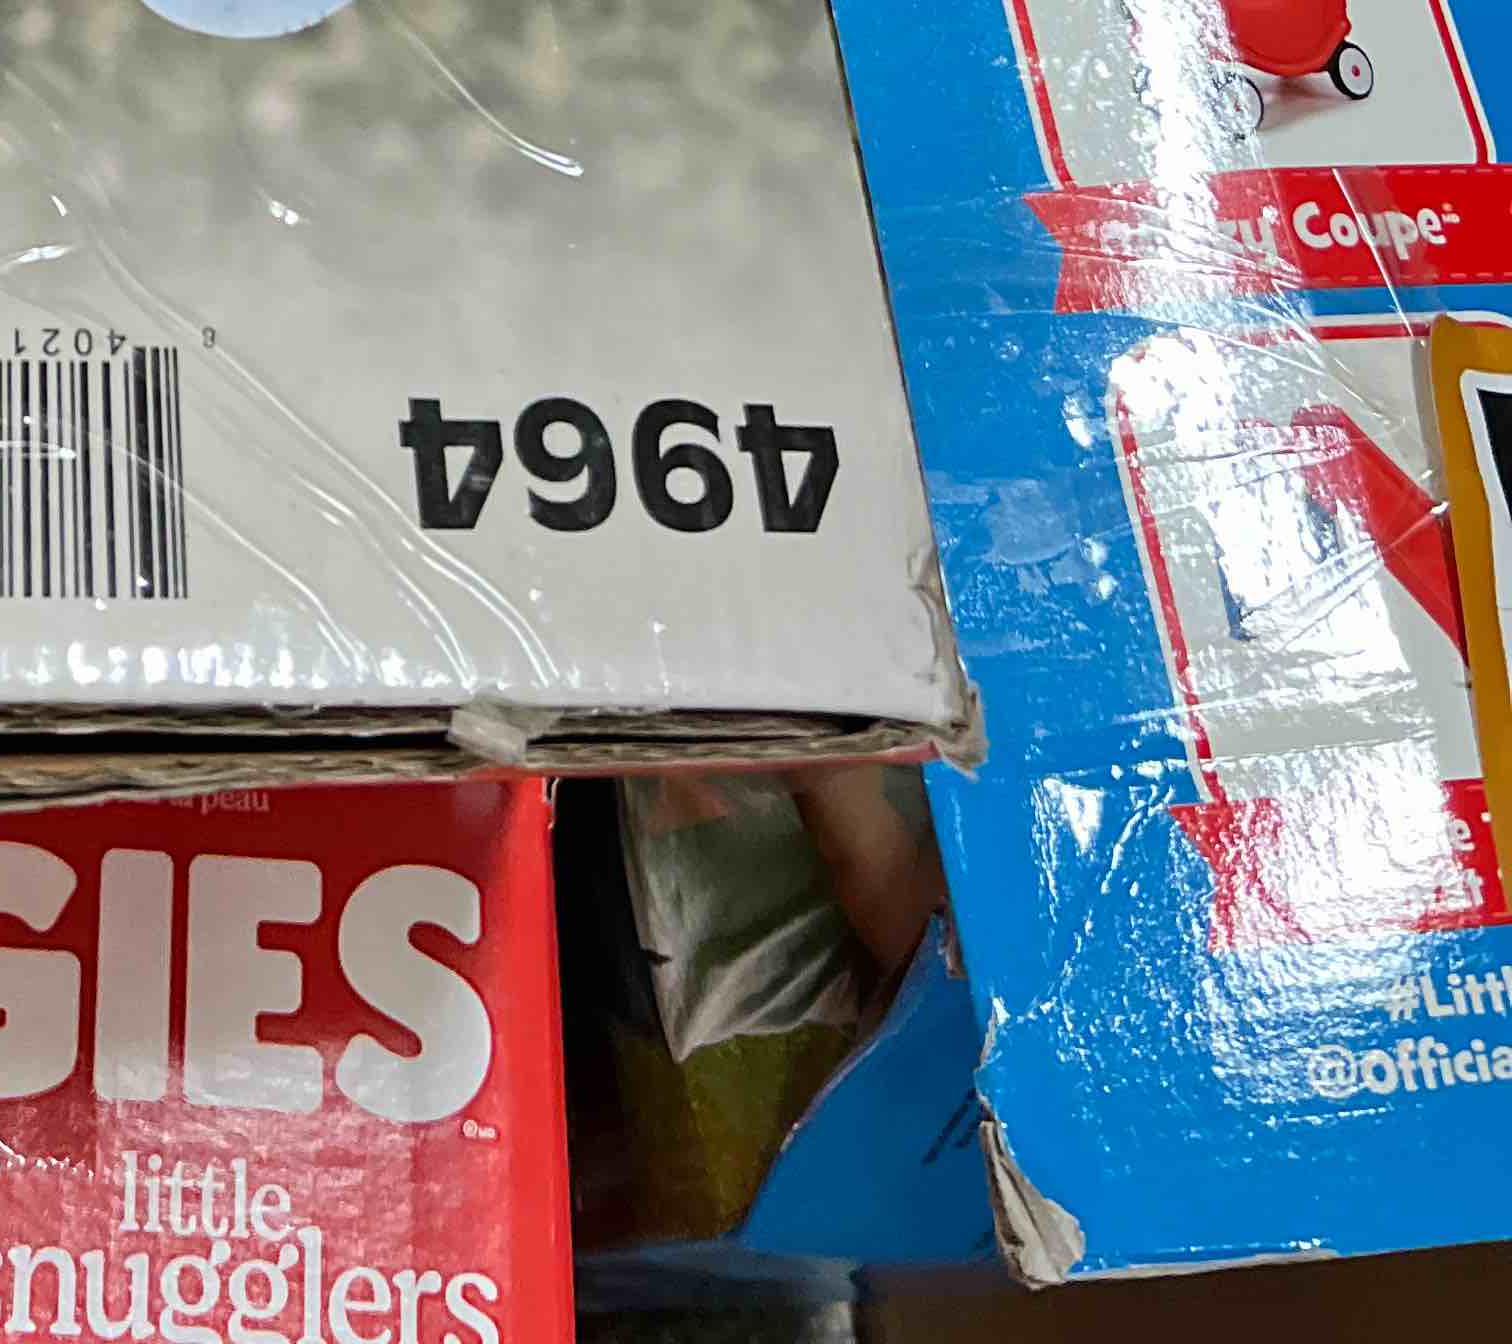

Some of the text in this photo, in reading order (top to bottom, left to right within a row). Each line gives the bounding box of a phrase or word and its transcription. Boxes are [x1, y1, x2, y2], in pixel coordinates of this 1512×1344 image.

[1292, 201, 1447, 261] Coupe
[397, 396, 840, 534] 4964
[200, 789, 271, 815] peau
[119, 1150, 294, 1241] little
